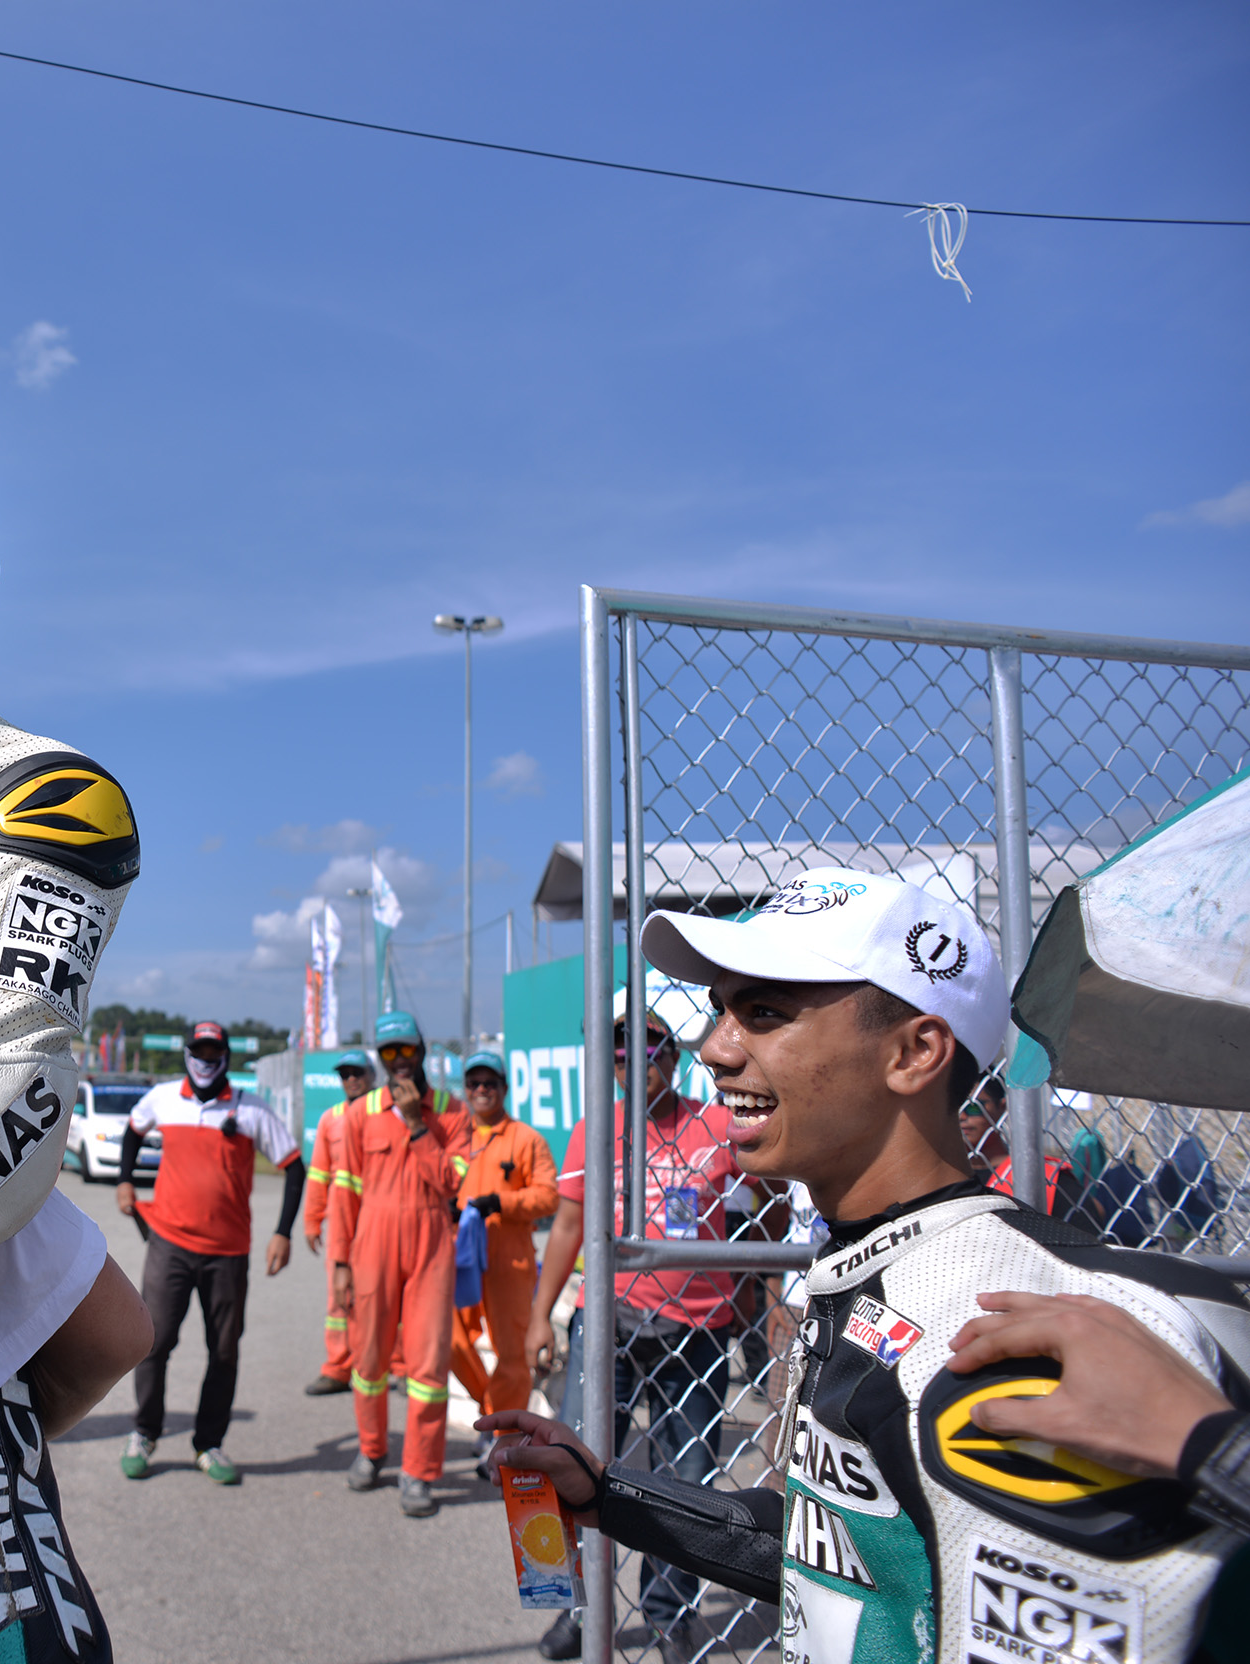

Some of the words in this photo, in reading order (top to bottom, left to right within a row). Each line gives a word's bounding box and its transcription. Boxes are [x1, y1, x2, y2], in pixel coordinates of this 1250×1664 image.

[20, 875, 85, 906] KOSO
[10, 895, 101, 960] NGK
[8, 930, 54, 948] SPARK
[59, 941, 93, 972] PLUGS
[928, 933, 952, 962] 1
[57, 1001, 81, 1026] CHAIN
[830, 1220, 923, 1279] TAICHI
[852, 1298, 885, 1326] uma
[846, 1316, 884, 1352] racing
[1, 1372, 94, 1656] TAIC
[975, 1543, 1079, 1592] KOSO
[972, 1572, 1128, 1664] NGK
[971, 1624, 1036, 1661] SPARK
